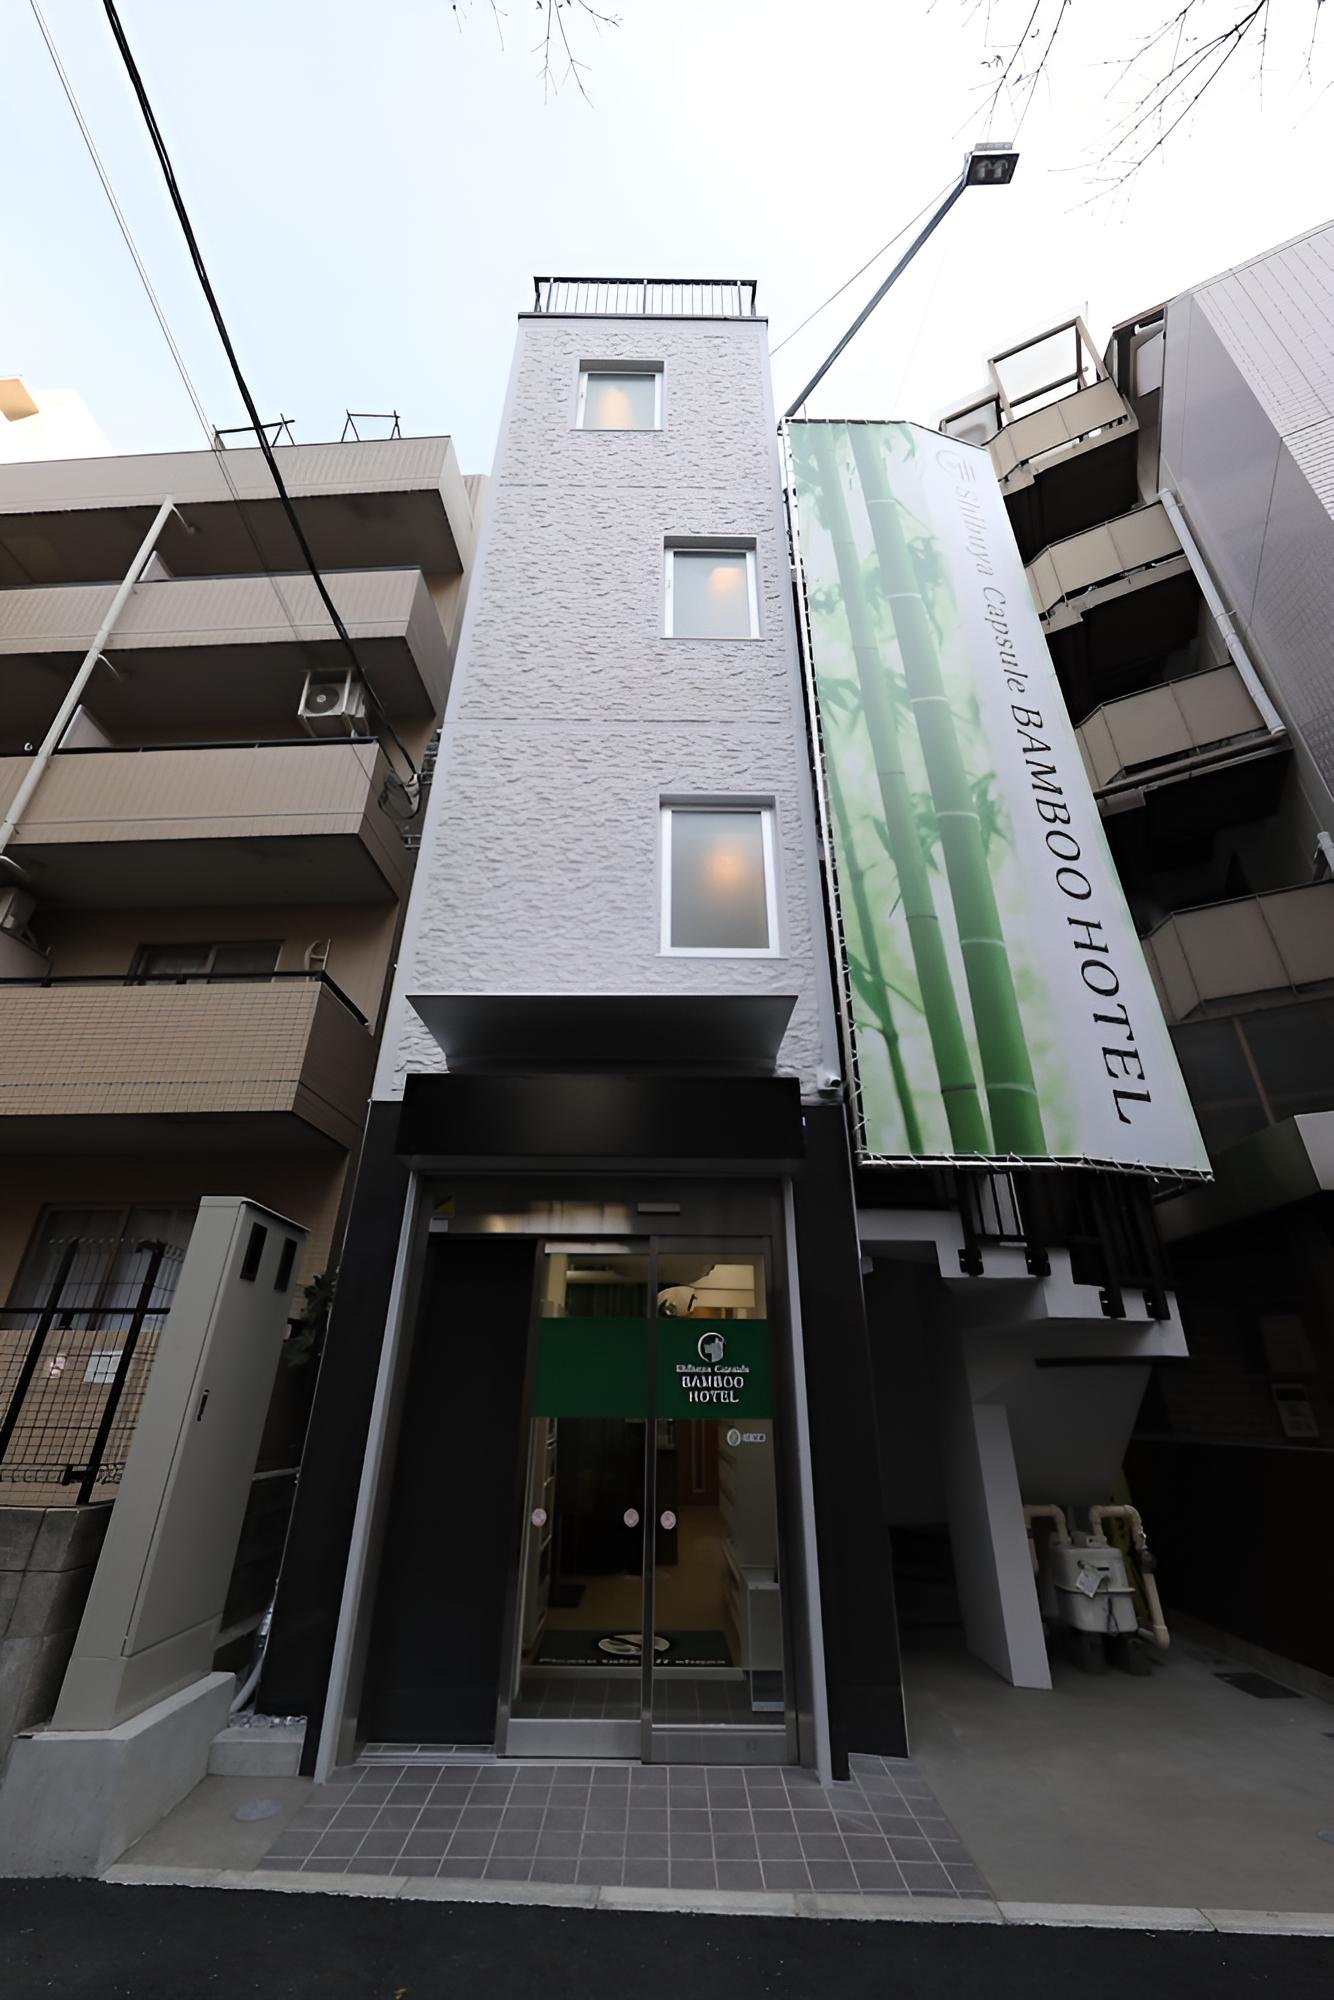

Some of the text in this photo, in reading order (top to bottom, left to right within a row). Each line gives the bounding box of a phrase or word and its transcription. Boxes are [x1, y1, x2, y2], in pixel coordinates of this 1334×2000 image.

[983, 586, 1028, 694] Capsule
[1011, 703, 1092, 901] BAMBOO
[1066, 916, 1152, 1125] HOTEL
[682, 1375, 744, 1388] BAMBOO
[689, 1390, 740, 1403] HOTEL
